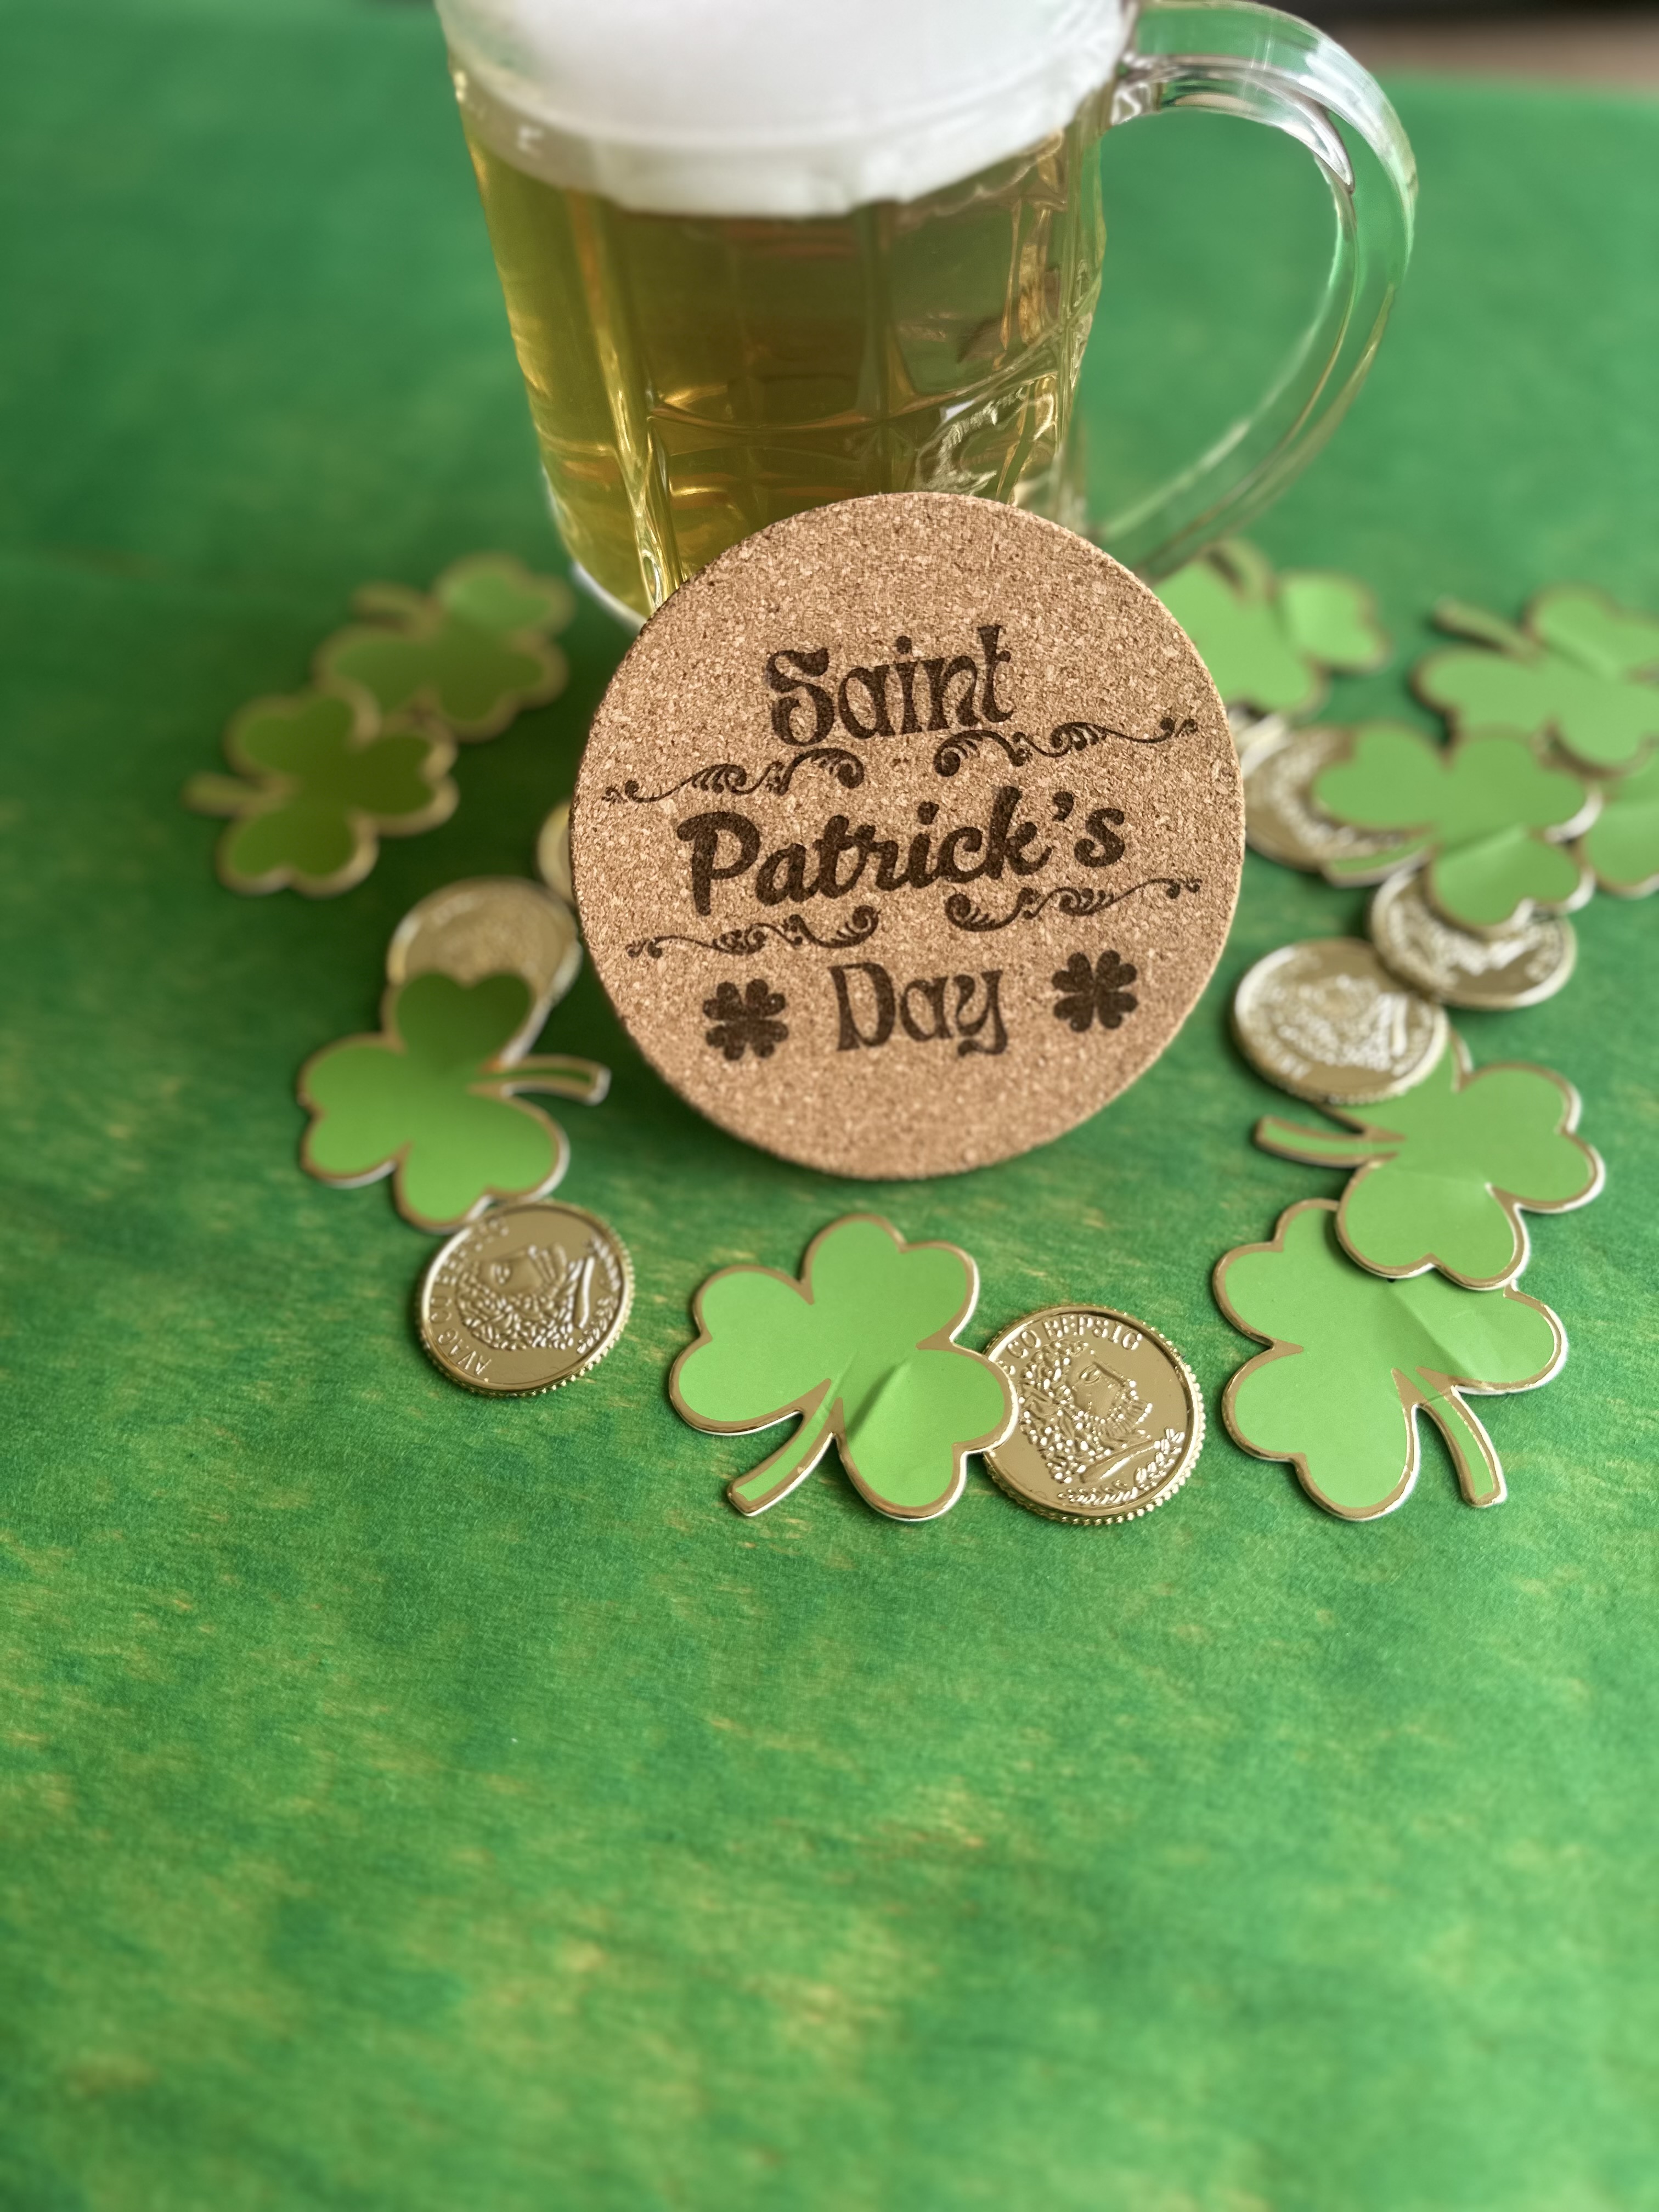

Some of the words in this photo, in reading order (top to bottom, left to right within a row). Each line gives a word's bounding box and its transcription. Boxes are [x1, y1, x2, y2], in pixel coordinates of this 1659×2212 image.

[766, 624, 1014, 747] Saint
[676, 786, 1126, 916] Patrick's
[828, 961, 1008, 1057] Day
